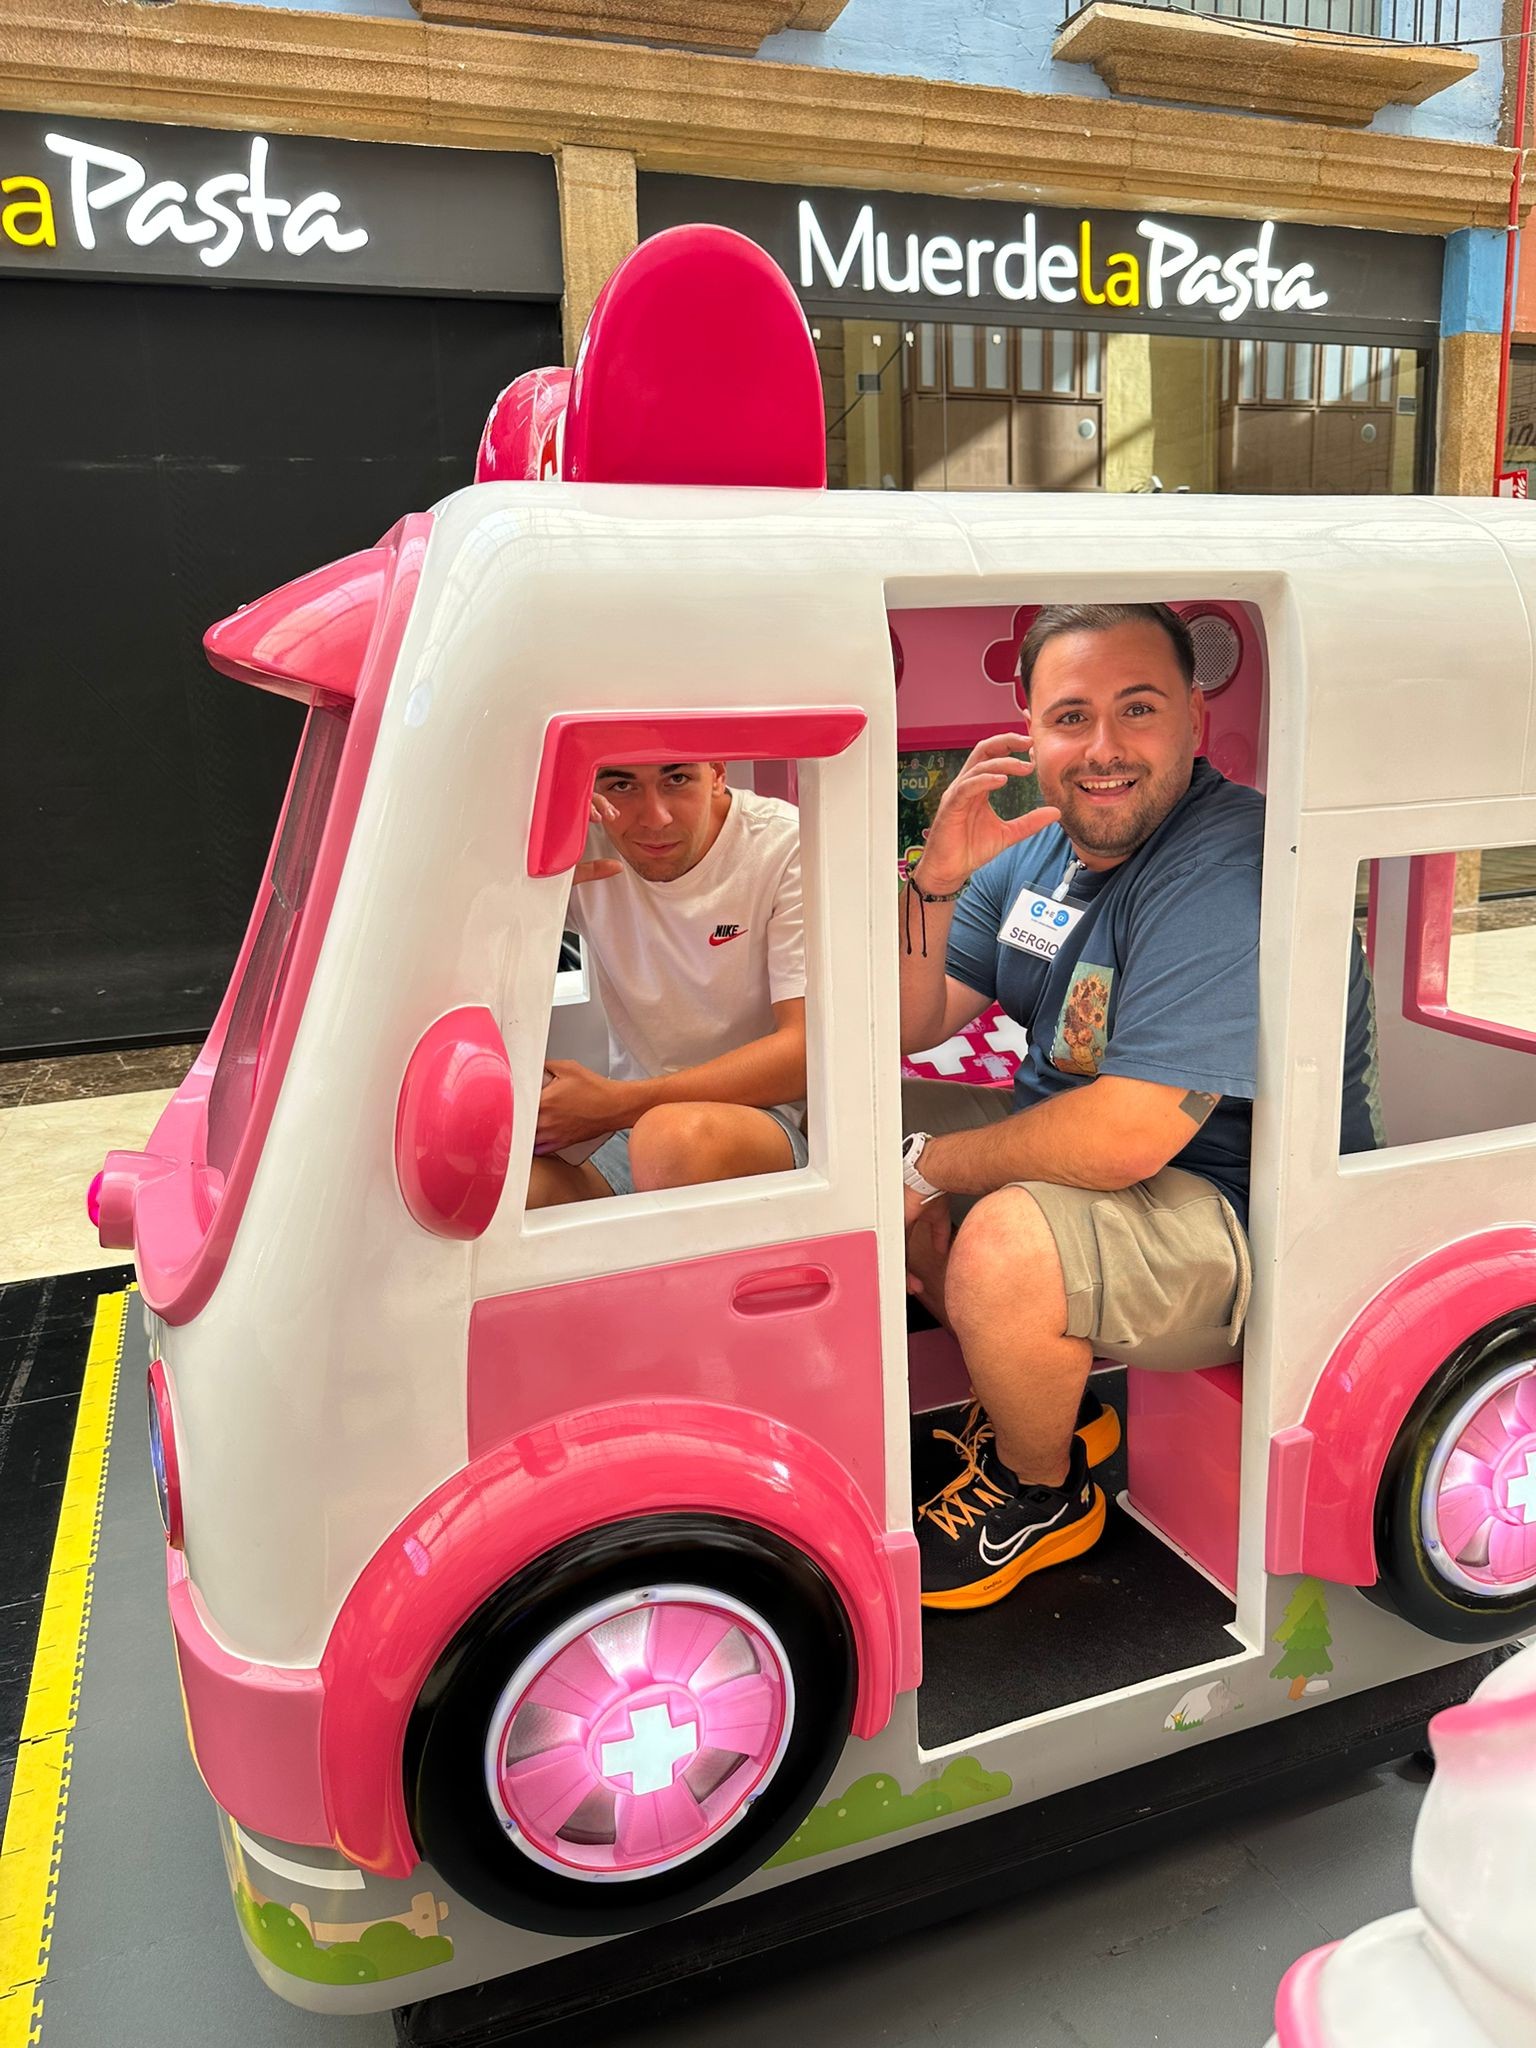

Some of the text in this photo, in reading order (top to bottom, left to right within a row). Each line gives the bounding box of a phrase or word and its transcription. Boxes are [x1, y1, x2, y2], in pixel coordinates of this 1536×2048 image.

[901, 777, 928, 790] POLI
[714, 924, 740, 938] NIKE
[1009, 927, 1060, 956] SERGIO
